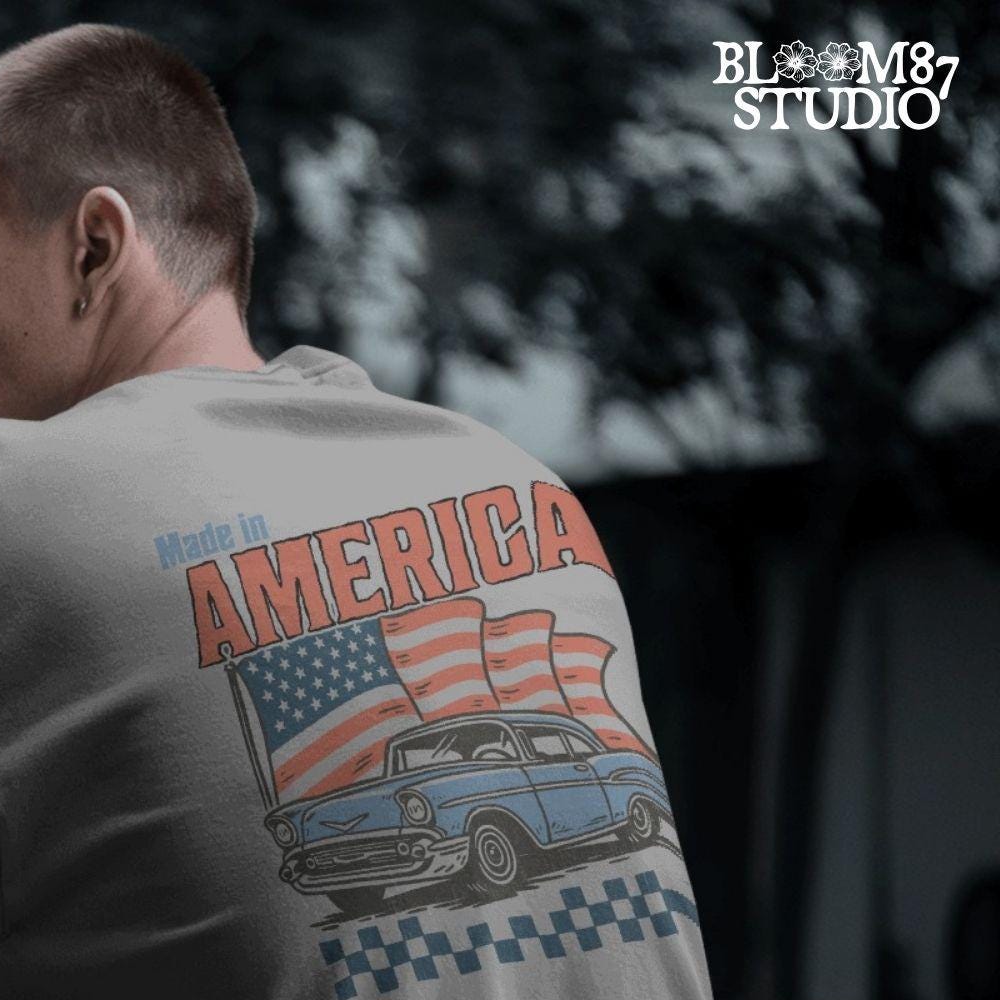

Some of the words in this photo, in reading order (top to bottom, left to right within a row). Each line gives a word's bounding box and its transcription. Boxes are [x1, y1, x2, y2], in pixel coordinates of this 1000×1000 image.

[153, 521, 236, 570] Made
[237, 512, 271, 545] in
[186, 480, 617, 669] AMERICA
